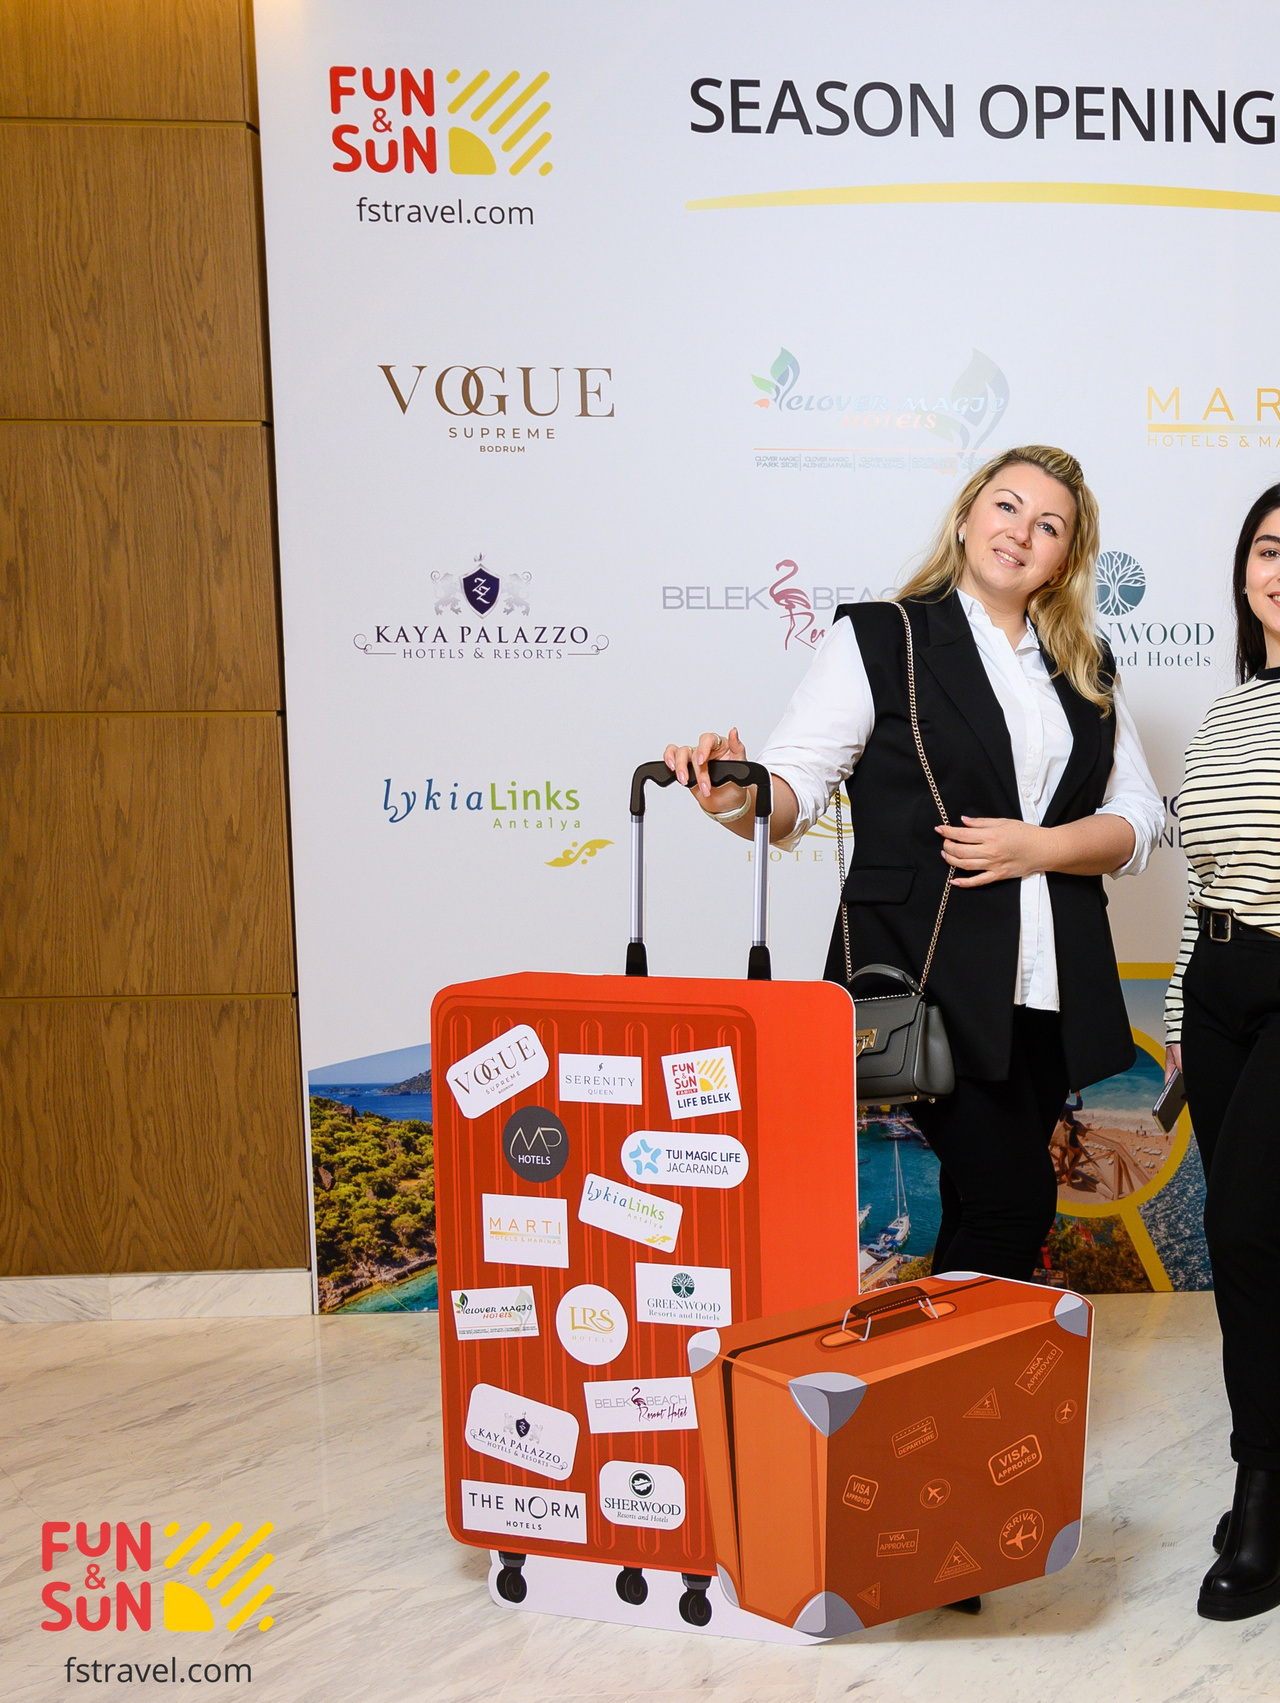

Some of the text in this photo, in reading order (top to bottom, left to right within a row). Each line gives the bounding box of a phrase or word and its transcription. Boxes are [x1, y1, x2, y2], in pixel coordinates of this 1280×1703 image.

[330, 66, 436, 117] FUN
[689, 77, 955, 138] SEASON
[979, 83, 1275, 145] OPENING
[372, 107, 394, 133] &
[331, 124, 438, 175] SUN
[356, 197, 535, 226] fstravel.com
[377, 364, 615, 418] VOGUE
[449, 427, 556, 440] SUPREME
[479, 445, 526, 453] BODRUM
[1147, 435, 1231, 448] HOTELS
[1238, 436, 1251, 449] &
[662, 586, 770, 610] BELEK
[375, 625, 589, 645] KAYA PALAZZO
[402, 648, 563, 660] HOTELS & RESORTS
[1114, 651, 1211, 667] nd Hotels
[493, 817, 582, 832] Antalya
[454, 1036, 536, 1095] VOGUE
[671, 1062, 695, 1076] FUN
[485, 1070, 521, 1095] SUPREME
[565, 1075, 636, 1087] SERENITY
[674, 1075, 697, 1089] SUN
[588, 1088, 614, 1096] QUEEN
[677, 1092, 732, 1108] LIFE BELEK
[518, 1154, 551, 1165] HOTELS
[666, 1149, 741, 1163] TUI MAGIC LIFE
[666, 1162, 729, 1175] JACARANDA
[489, 1216, 562, 1234] MARTI
[627, 1212, 662, 1229] Antalya
[647, 1298, 721, 1313] GREENWOOD
[569, 1306, 615, 1334] LRS
[649, 1310, 675, 1318] Resorts
[695, 1313, 720, 1321] Hotels
[571, 1335, 613, 1343] HOTELS
[1026, 1357, 1043, 1375] VISA
[1027, 1349, 1057, 1389] APPROVED
[595, 1395, 687, 1408] BELEK BEACH
[479, 1428, 560, 1463] KAYA PALAZZO
[898, 1433, 934, 1455] DEPARTURE
[487, 1441, 511, 1454] HOTELS
[521, 1453, 549, 1467] RESORTS
[999, 1445, 1029, 1467] VISA
[998, 1453, 1037, 1479] APPROVED
[852, 1481, 870, 1496] VISA
[469, 1492, 579, 1519] THE NORM
[604, 1497, 681, 1516] SHERWOOD
[846, 1493, 870, 1505] APPROVED
[506, 1520, 542, 1530] HOTELS
[638, 1513, 649, 1521] and
[1003, 1513, 1037, 1538] ARRIVAL
[880, 1541, 915, 1550] APPROVED
